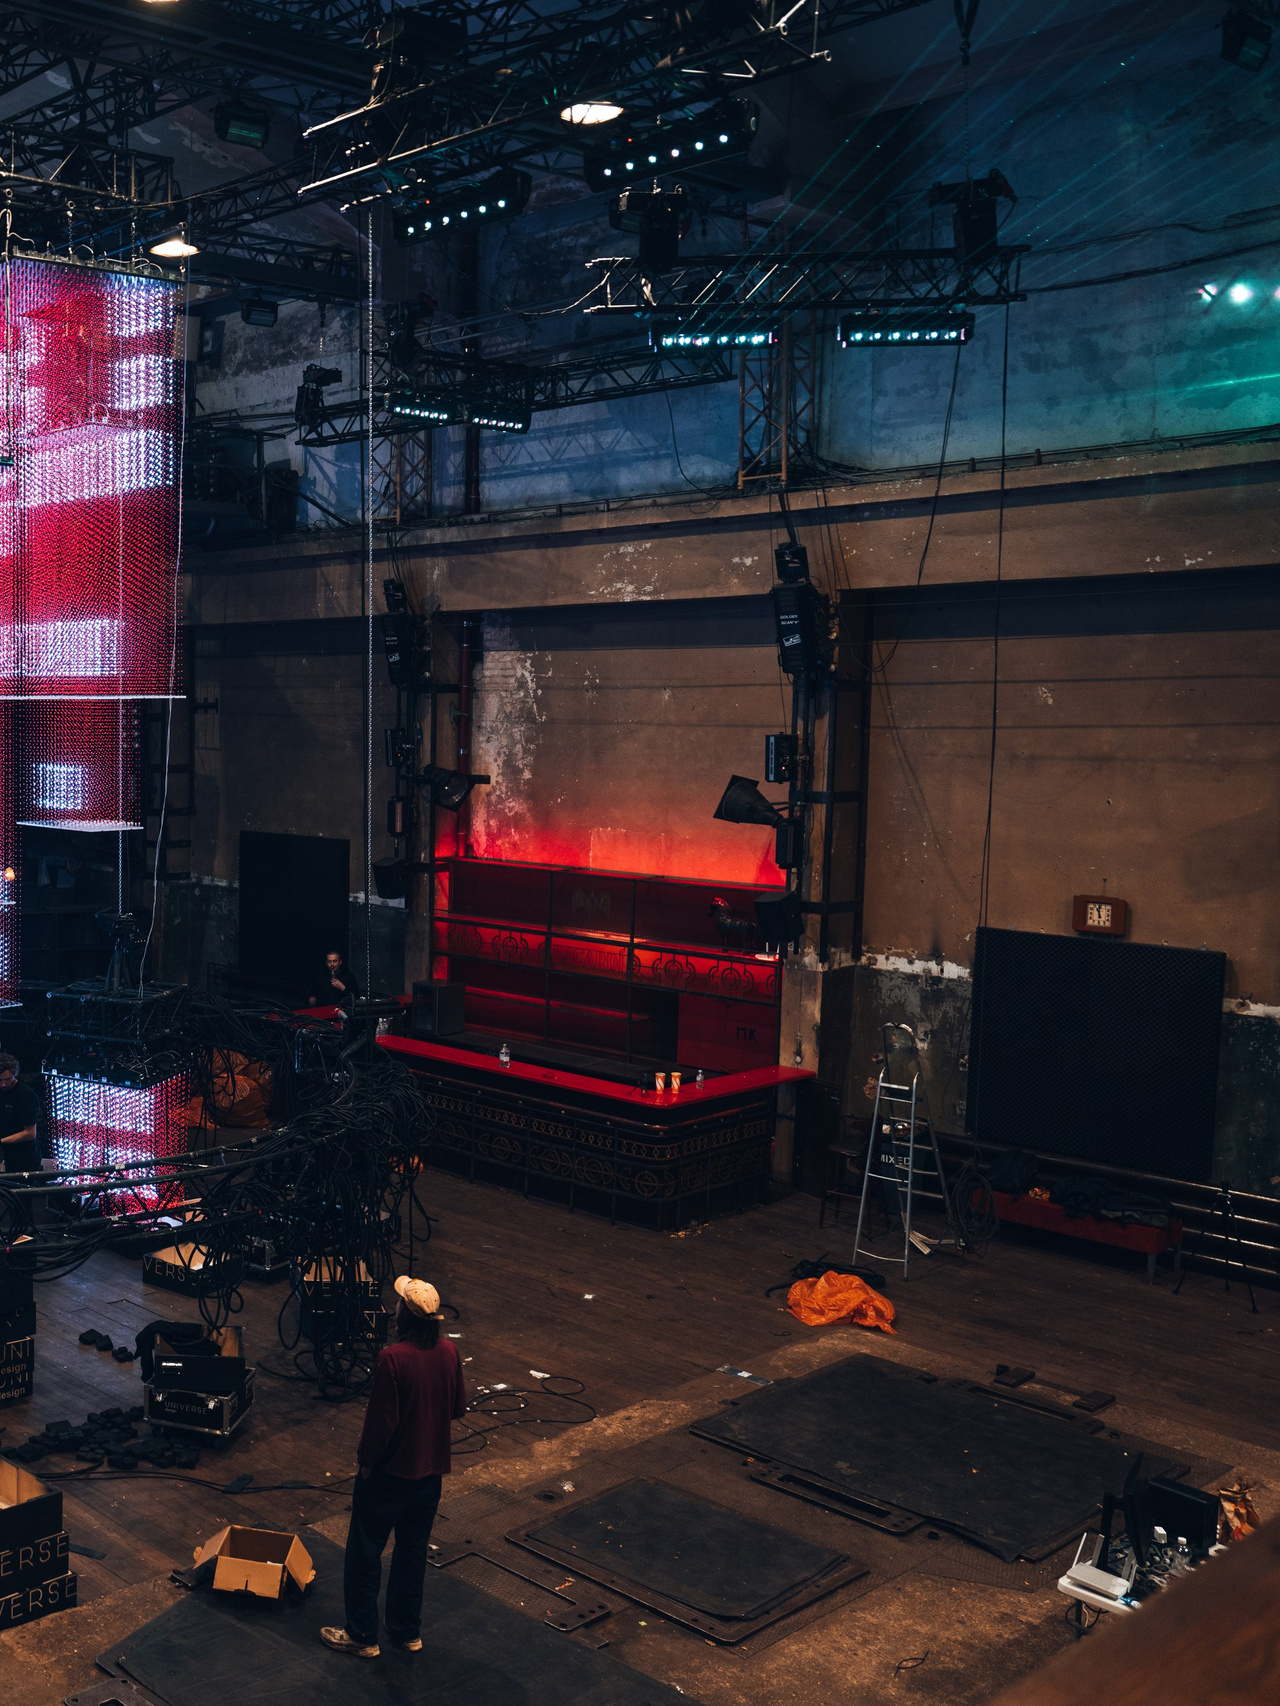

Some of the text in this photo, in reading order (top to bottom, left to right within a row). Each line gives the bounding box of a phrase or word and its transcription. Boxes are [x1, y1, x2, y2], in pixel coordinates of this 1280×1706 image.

[736, 1026, 757, 1042] ПК
[143, 1255, 194, 1286] VERS
[164, 1401, 207, 1415] UNIVERSE
